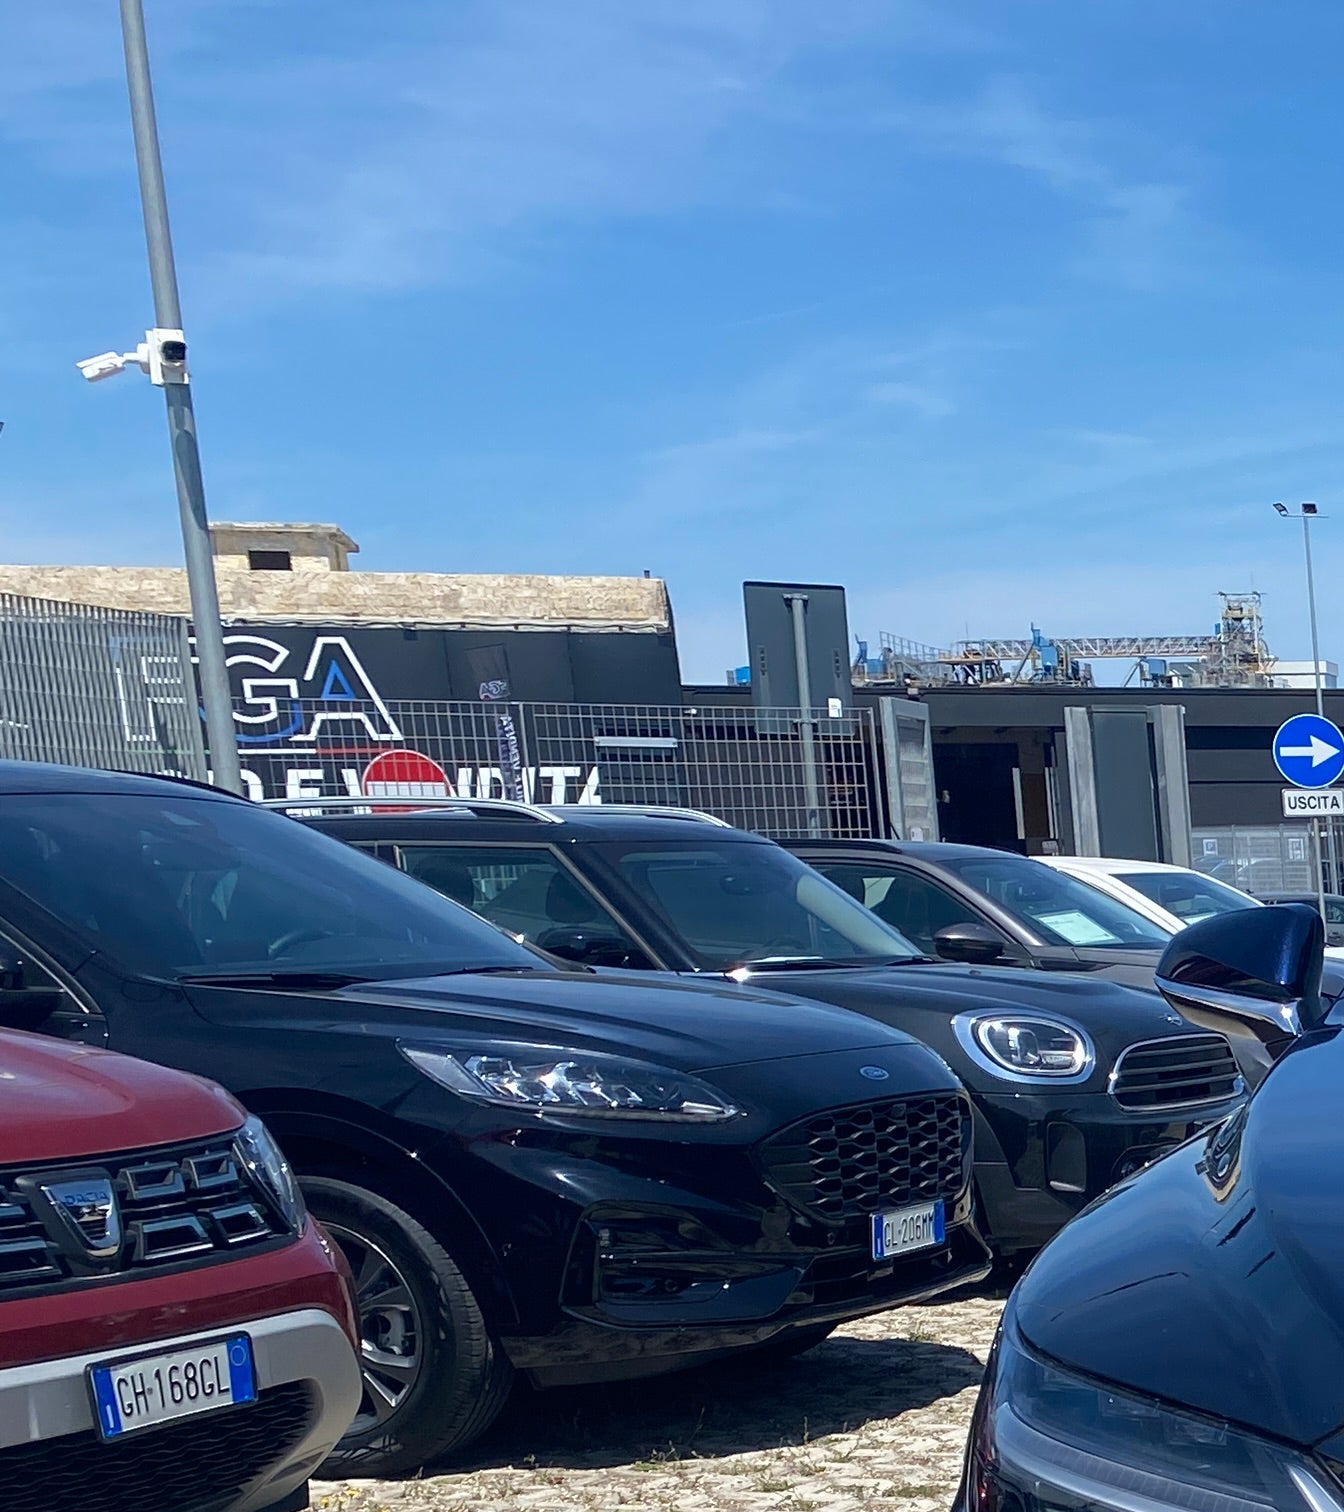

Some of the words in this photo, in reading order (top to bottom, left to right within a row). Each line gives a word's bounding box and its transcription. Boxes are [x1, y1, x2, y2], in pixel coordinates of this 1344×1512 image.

[109, 634, 405, 743] FGA
[1287, 795, 1341, 810] USCITA
[63, 1191, 111, 1206] DACIA
